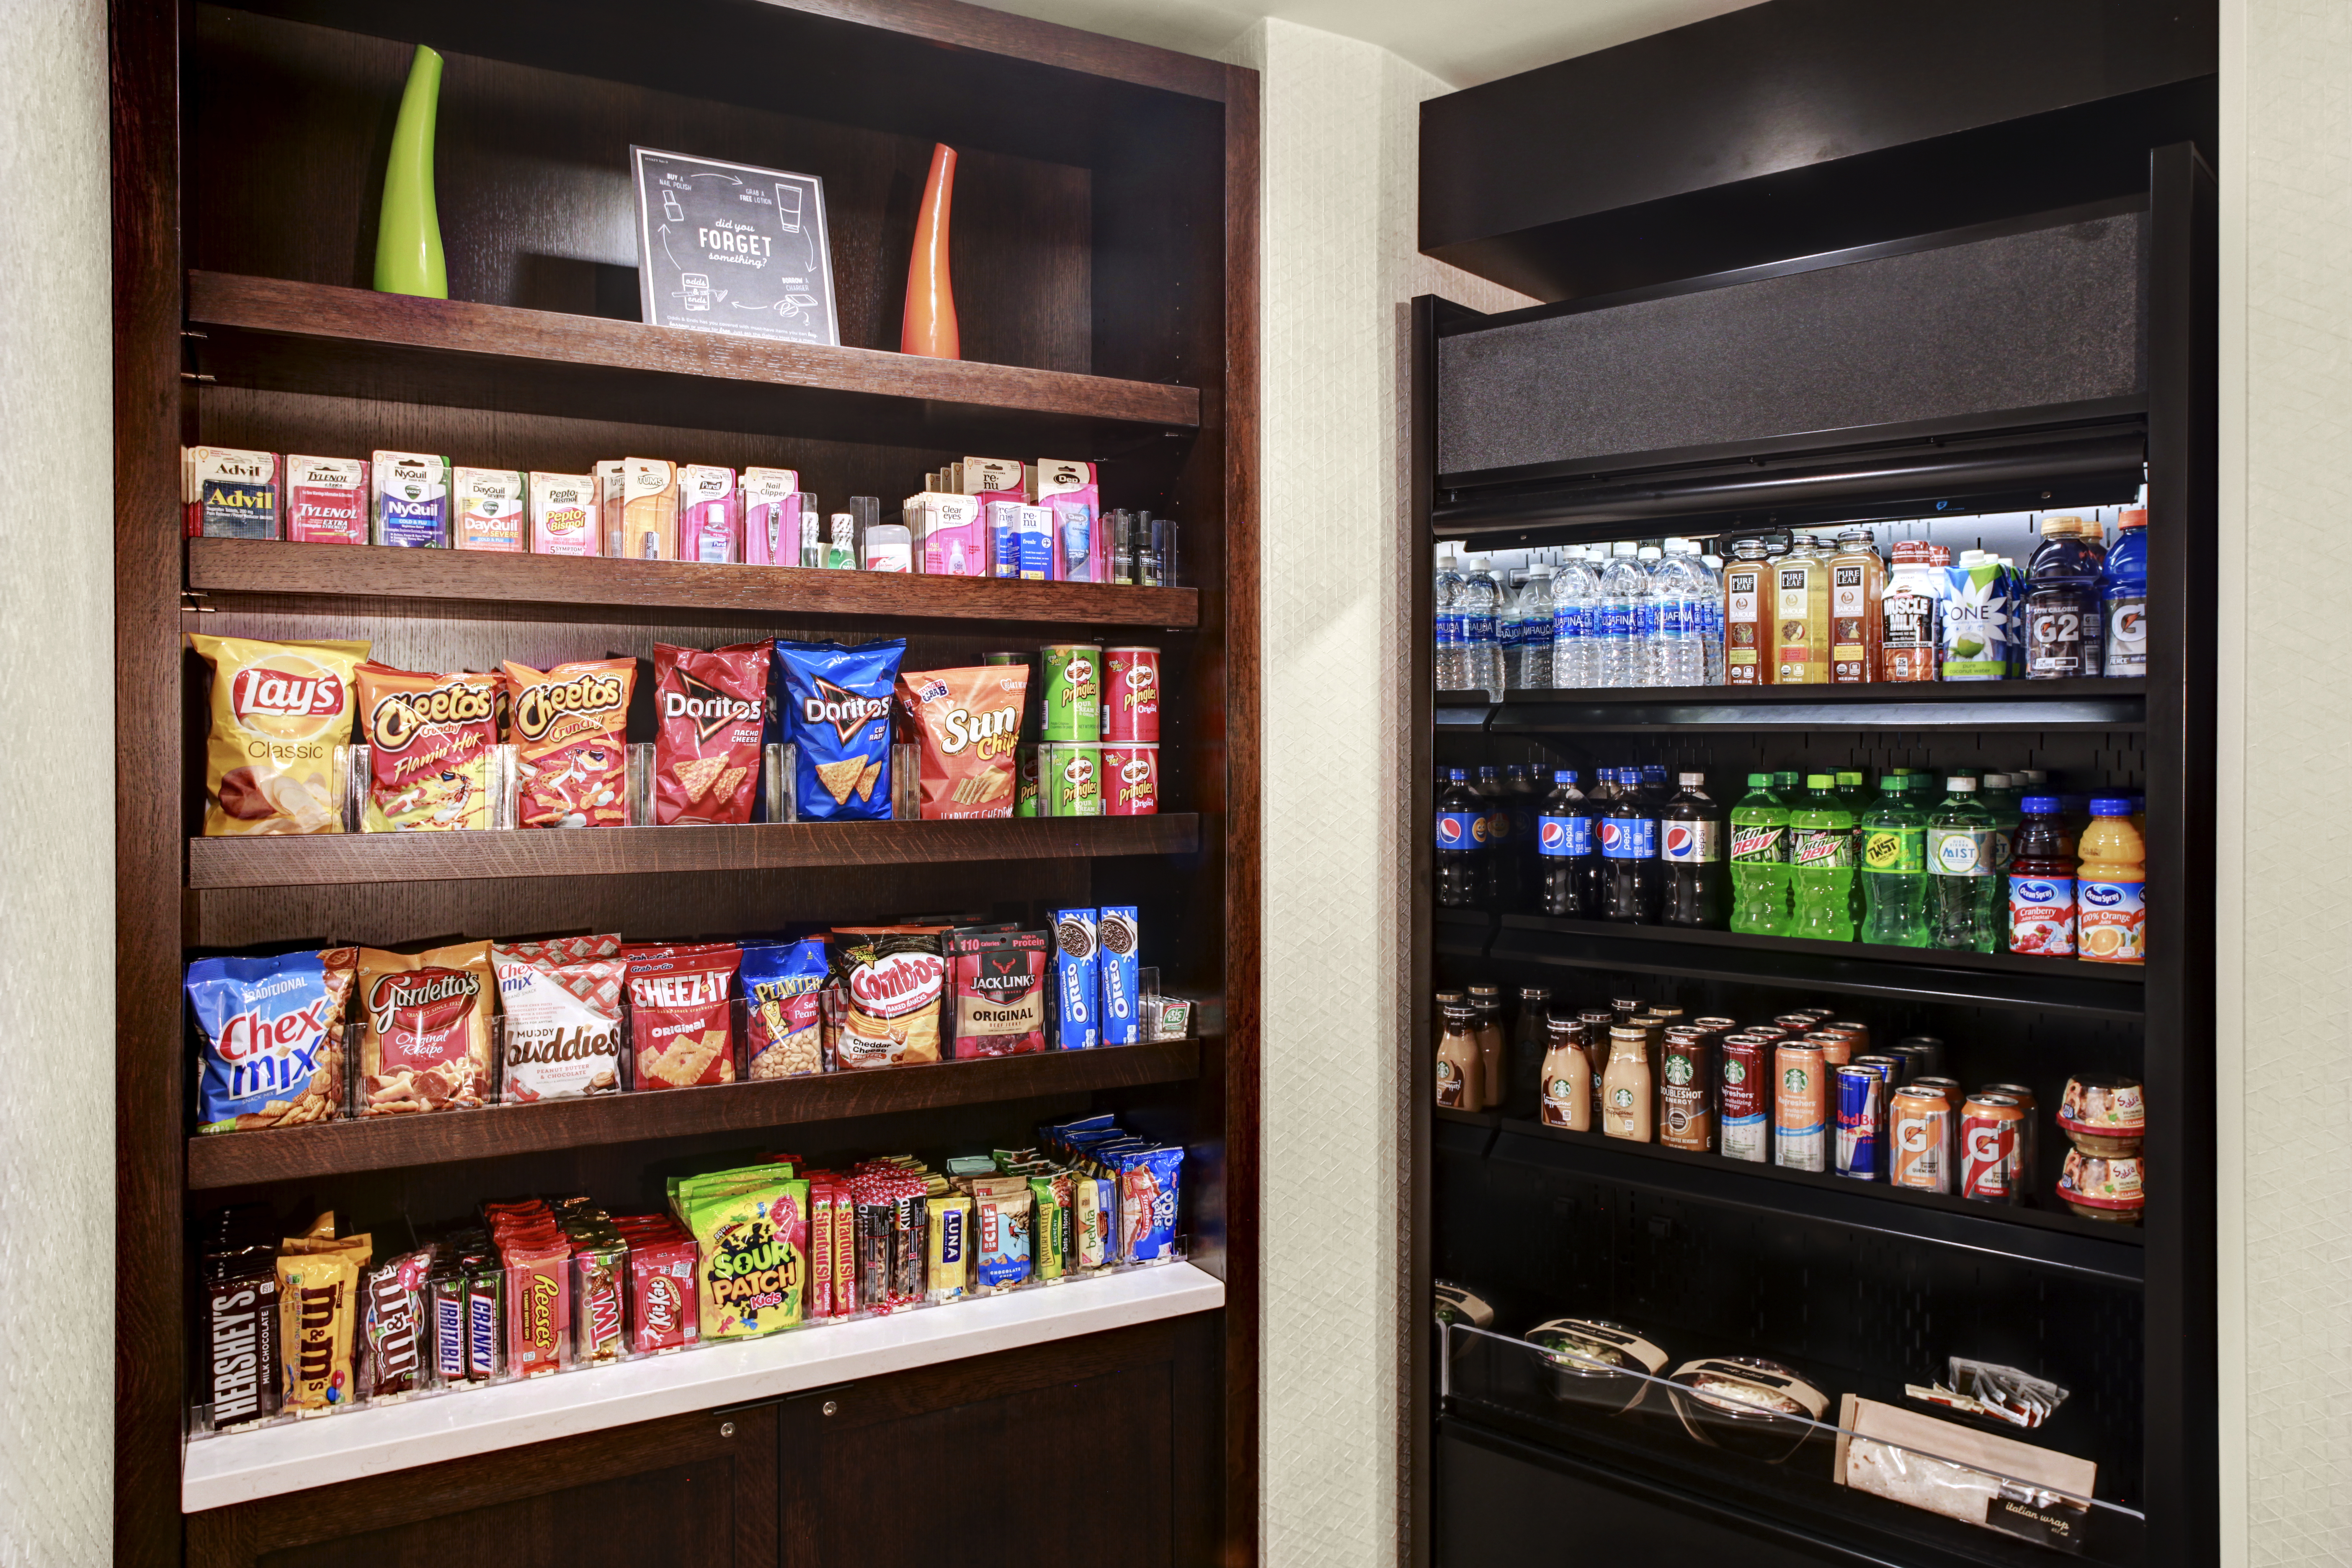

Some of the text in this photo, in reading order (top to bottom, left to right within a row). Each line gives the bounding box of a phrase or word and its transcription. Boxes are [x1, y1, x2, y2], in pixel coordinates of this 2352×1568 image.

[660, 179, 691, 191] NAIL POLISH
[667, 173, 678, 181] BUY
[754, 197, 772, 205] LOTION
[715, 218, 755, 233] did you
[699, 227, 771, 257] FORGET
[709, 252, 768, 269] something?
[686, 278, 707, 286] odds
[216, 464, 260, 477] Advil
[307, 471, 348, 482] TYLENOL
[395, 469, 426, 480] NyQuil
[637, 475, 663, 487] TUMS
[701, 481, 722, 490] Purell
[206, 487, 272, 509] Advil
[473, 486, 505, 495] DayQuil
[760, 489, 786, 497] Clipper
[298, 503, 358, 519] TYLENOL
[389, 501, 438, 518] NyQuil
[942, 505, 962, 514] Clear
[464, 517, 518, 534] DayQuil
[550, 546, 555, 554] 5
[1884, 598, 1928, 616] MUSCLE
[1654, 611, 1694, 622] AQUAFINA
[1889, 614, 1919, 631] MILK
[241, 670, 338, 716] Lay's
[1062, 680, 1096, 707] Pringles
[1124, 686, 1156, 712] Pringles
[517, 677, 621, 739] Cheetos
[666, 693, 761, 720] Doritos
[807, 696, 890, 722] Doritos
[1138, 704, 1157, 714] Original
[374, 685, 493, 752] Cheetos
[549, 715, 603, 742] Crunchy
[942, 706, 1017, 753] Sun
[248, 740, 323, 759] Classic
[1063, 780, 1096, 807] Pringles
[1119, 782, 1153, 807] Pringles
[1623, 825, 1632, 851] pepsi
[1942, 847, 1975, 858] MIST
[2020, 908, 2057, 918] Cranberry
[2083, 911, 2131, 923] 100% Orange
[1012, 937, 1044, 947] Protein
[498, 963, 534, 980] Chex
[853, 957, 943, 1000] Combos
[970, 974, 1036, 990] JACK LINK'S
[1109, 959, 1130, 1019] OREO
[887, 993, 927, 1012] BAKED SNACKS
[1068, 963, 1089, 1024] OREO
[972, 1007, 1033, 1021] ORIGINAL
[220, 1000, 325, 1062] Chex
[517, 1028, 554, 1038] MUDDY
[506, 1026, 619, 1067] buddies
[853, 1039, 891, 1048] Cheddar
[547, 1070, 586, 1079] CHOCOLATE
[1665, 1096, 1693, 1105] ENERGY
[1777, 1095, 1816, 1108] Refreshers
[900, 1198, 910, 1230] KIND
[1141, 1194, 1151, 1234] Strawberry
[983, 1208, 996, 1242] CLIF
[947, 1213, 959, 1259] LUNA
[1040, 1205, 1051, 1265] NATURE VALLEY
[815, 1211, 831, 1281] Starburst
[839, 1210, 854, 1281] Starburst
[714, 1241, 790, 1279] SOUR
[990, 1266, 1021, 1275] CHOCOLATE
[712, 1261, 796, 1305] PATCH
[750, 1292, 782, 1310] Kids
[260, 1310, 269, 1363] CHOCOLATE
[472, 1299, 492, 1369] CRANKY
[212, 1289, 258, 1421] HERSHEY'S
[2005, 1501, 2070, 1531] italian wrap
